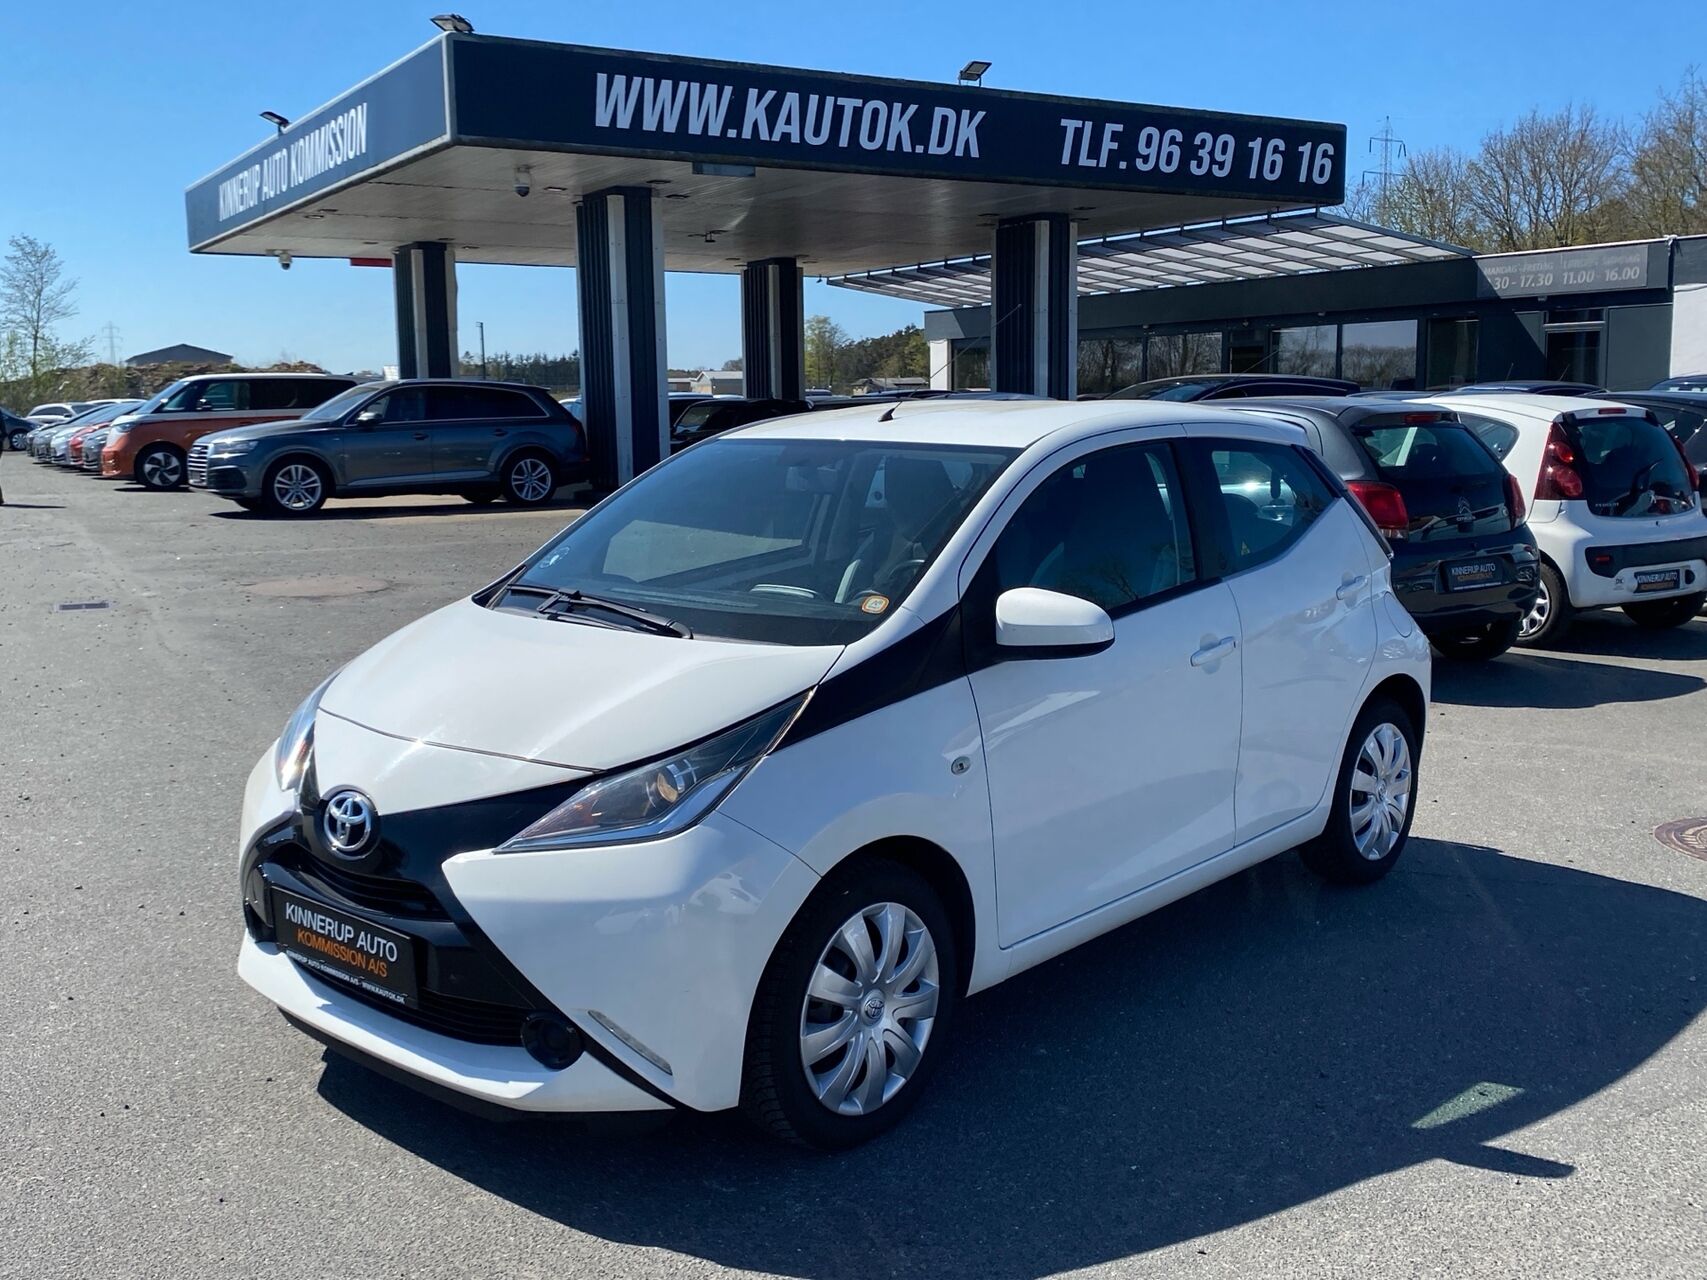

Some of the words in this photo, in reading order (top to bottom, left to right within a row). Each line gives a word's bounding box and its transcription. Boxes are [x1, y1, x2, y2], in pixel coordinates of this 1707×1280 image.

[595, 72, 987, 159] WWW.KAUTOK.DK
[219, 164, 261, 222] KINNERUP
[262, 148, 288, 201] AUTO
[290, 102, 368, 188] KOMMISSION
[1060, 118, 1127, 170] TLF.
[1135, 126, 1183, 173] 96
[1190, 132, 1235, 178] 39
[1248, 137, 1286, 181] 16
[1298, 141, 1335, 185] 16
[1520, 272, 1554, 288] 17.30
[1562, 269, 1596, 285] 11.00
[1605, 265, 1641, 282] 16.00
[285, 902, 354, 943] KINNERUP
[356, 931, 398, 962] AUTO
[297, 928, 367, 969] KOMMISSION
[367, 957, 388, 978] A/S
